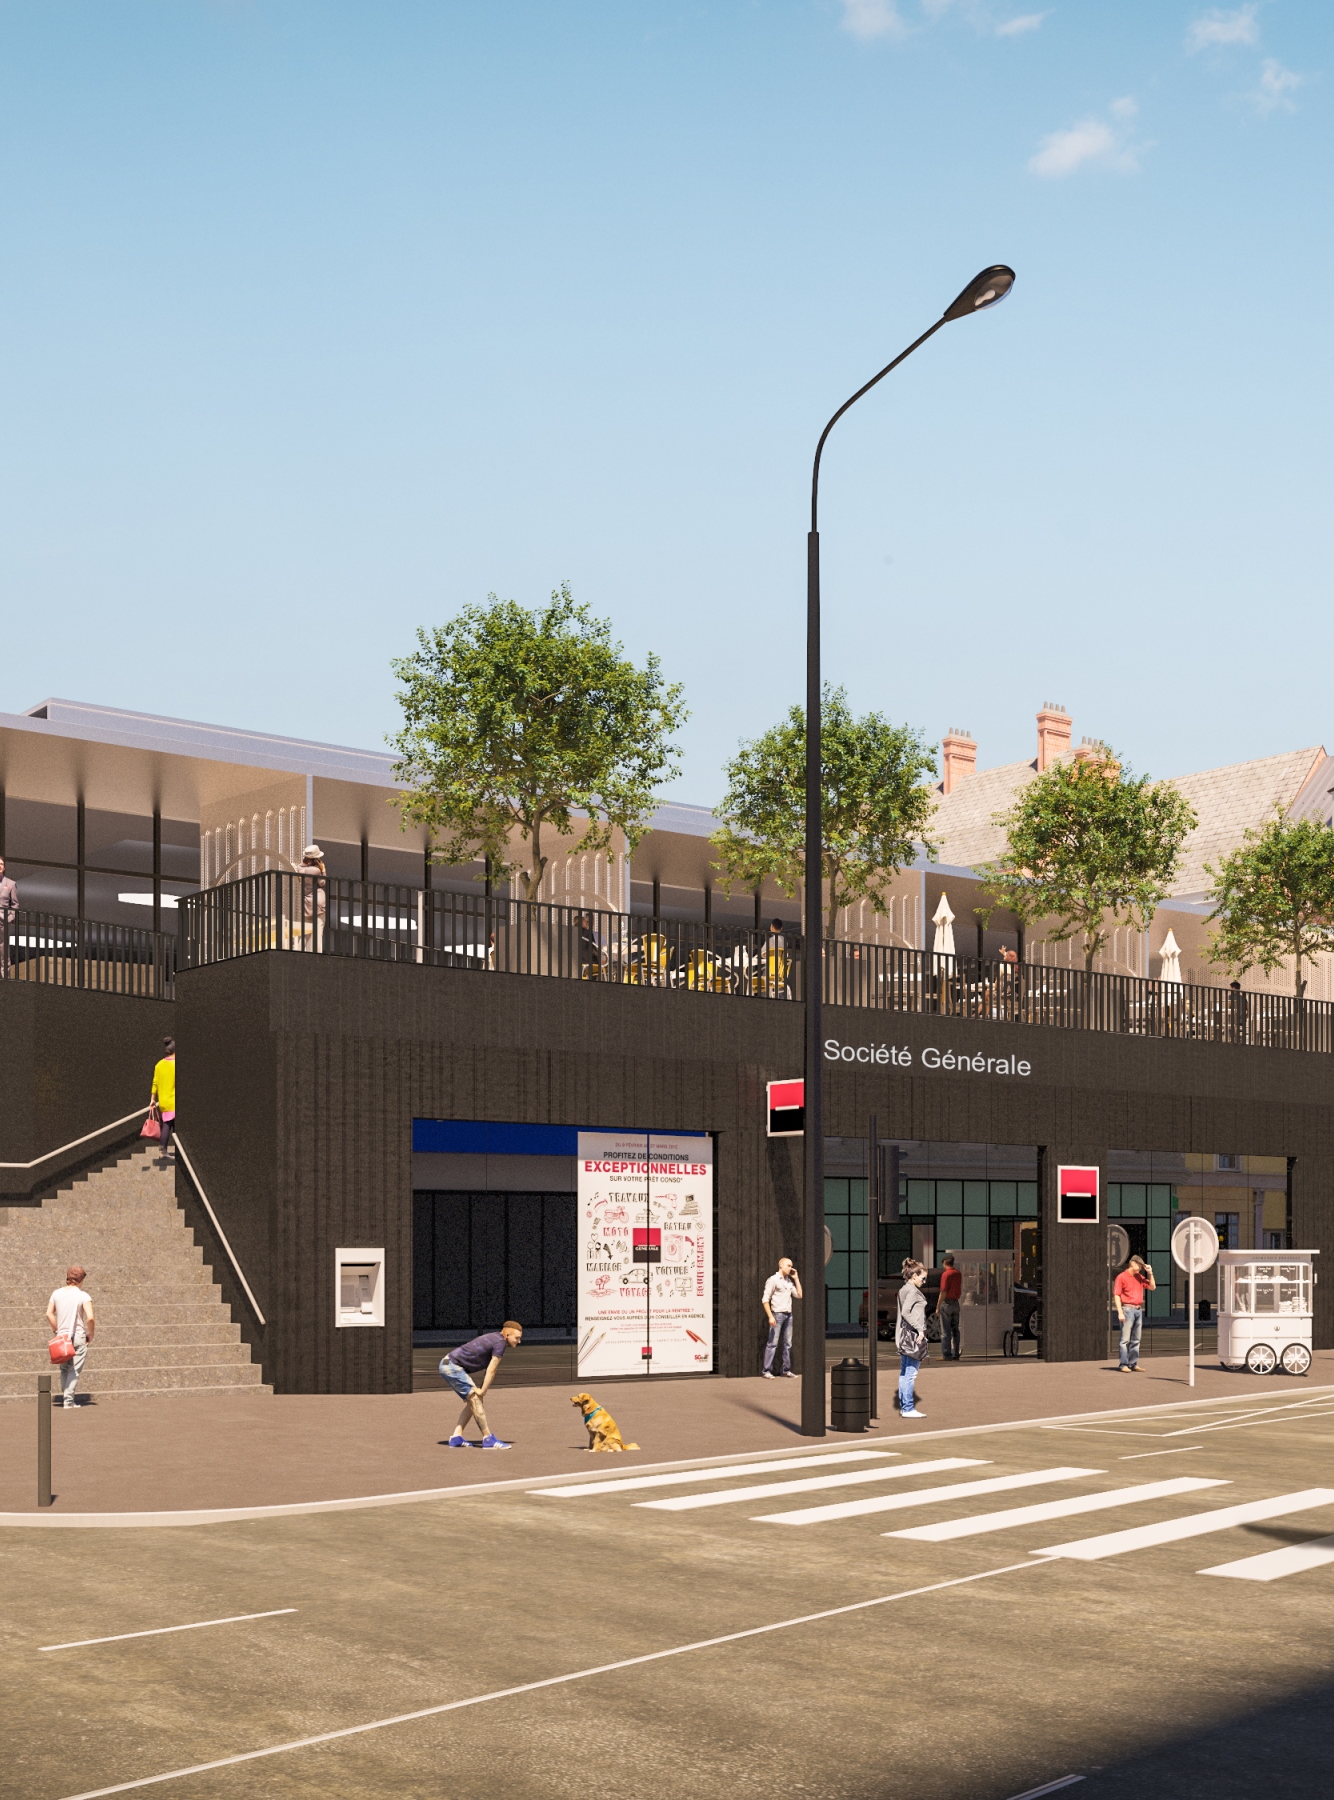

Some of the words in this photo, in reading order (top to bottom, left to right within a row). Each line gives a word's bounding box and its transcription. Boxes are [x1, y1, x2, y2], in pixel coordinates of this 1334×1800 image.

[823, 1039, 913, 1067] Société
[921, 1047, 1032, 1077] Générale
[603, 1151, 636, 1159] PROFITEZ
[648, 1153, 689, 1161] CONDITIONS
[584, 1161, 707, 1175] EXCEPTIONNELLES
[644, 1175, 659, 1183] PRÊT
[663, 1221, 692, 1231] BATEAU
[603, 1226, 629, 1237] MOTO
[586, 1262, 622, 1272] MARIAGE
[655, 1266, 689, 1276] VOITURE
